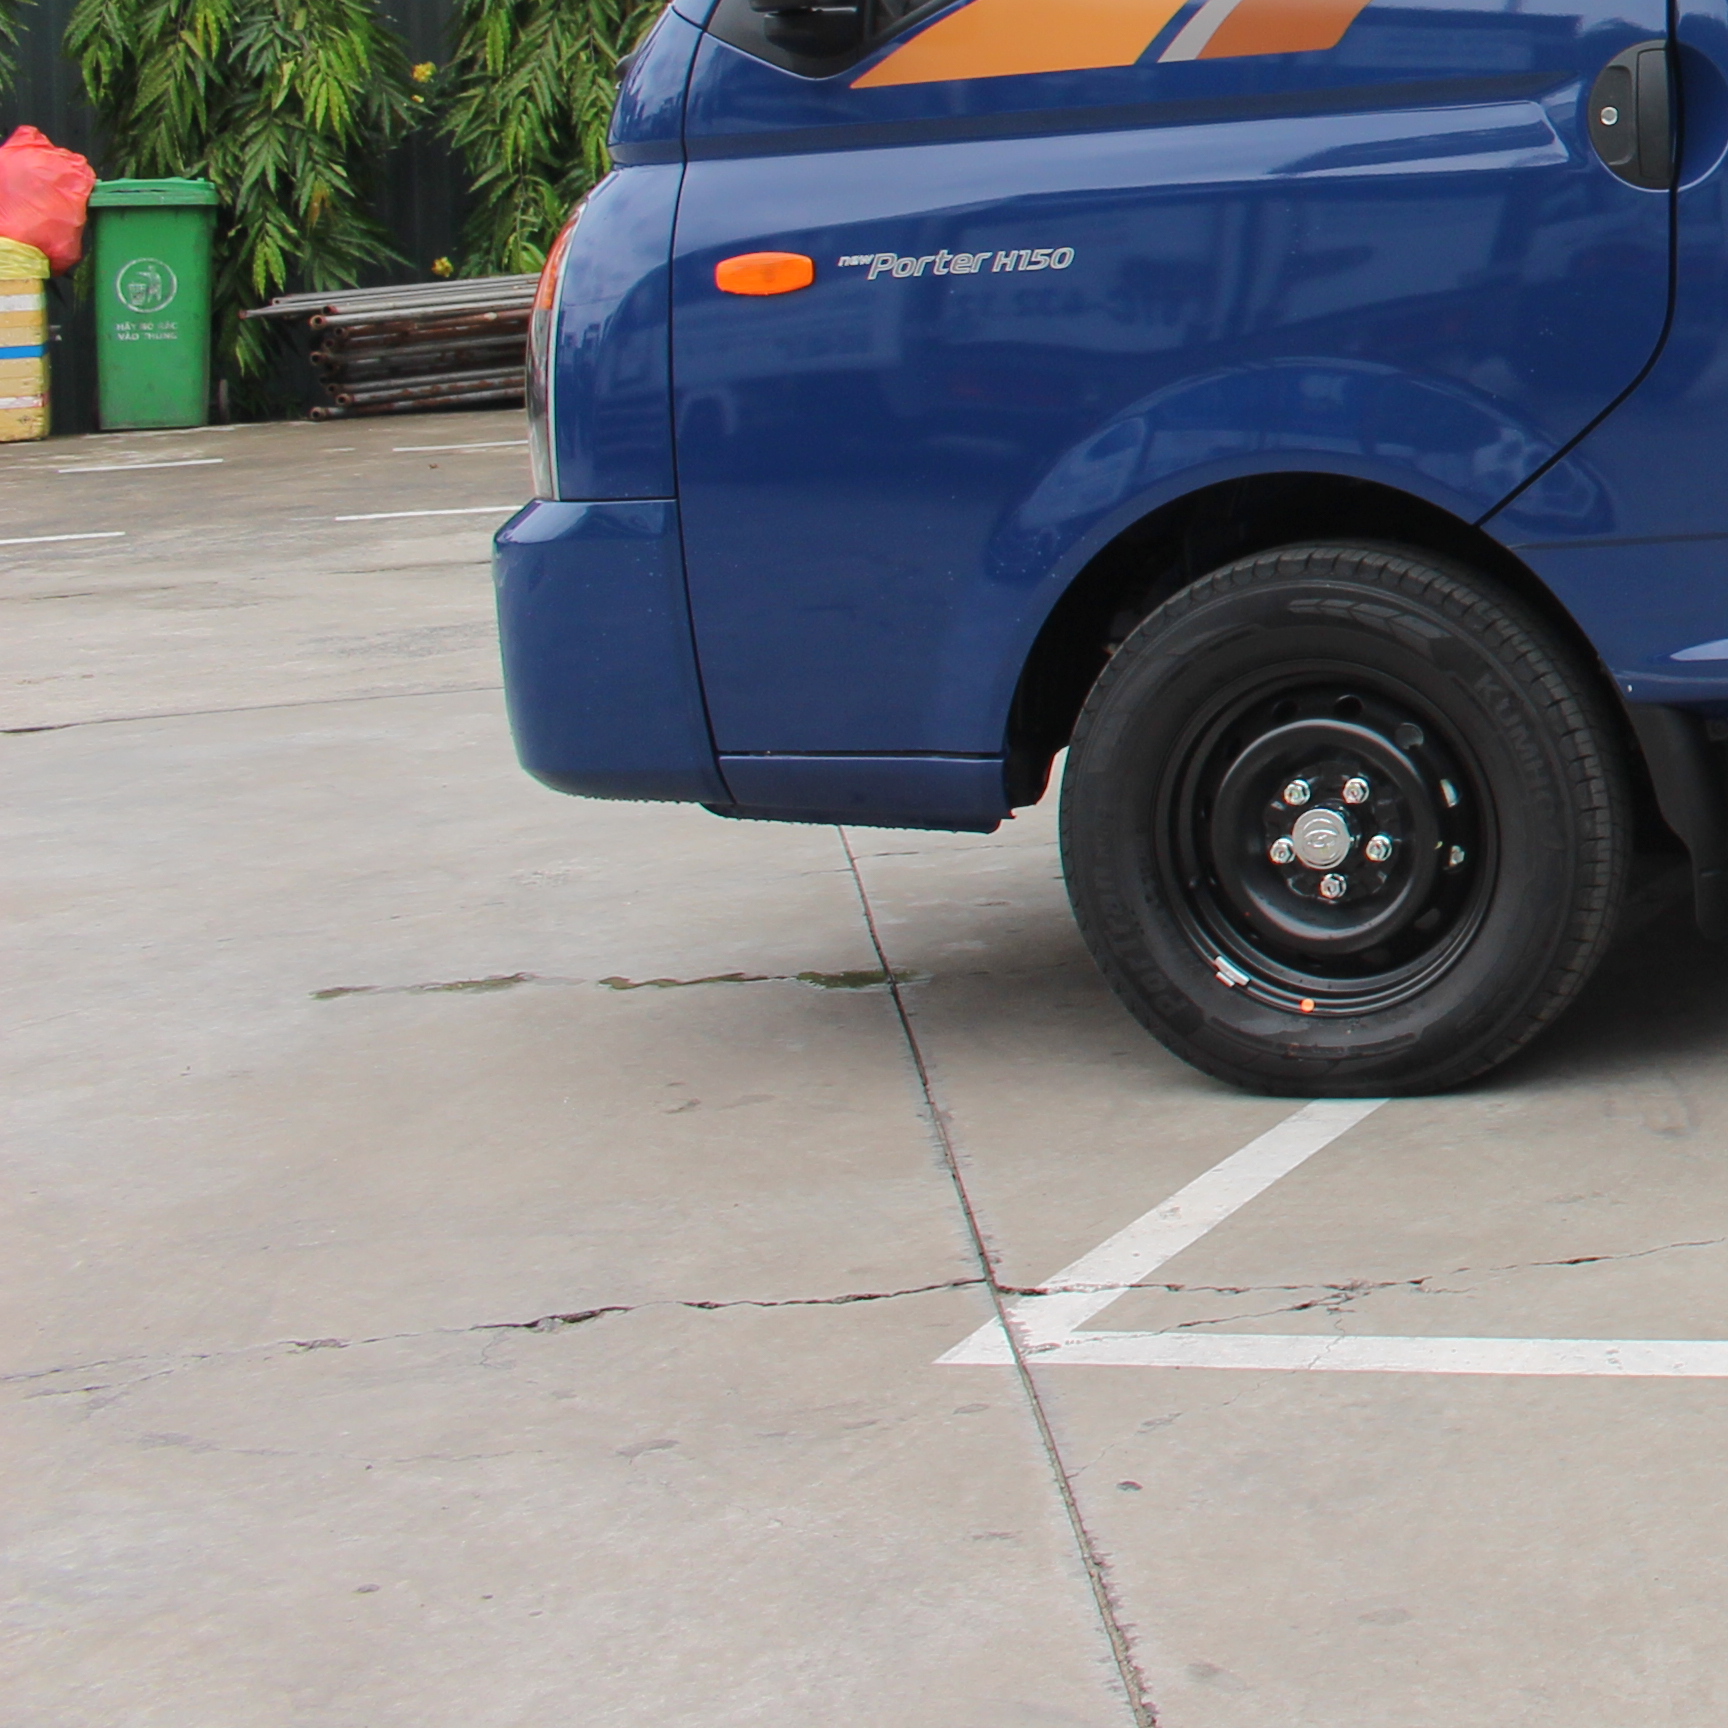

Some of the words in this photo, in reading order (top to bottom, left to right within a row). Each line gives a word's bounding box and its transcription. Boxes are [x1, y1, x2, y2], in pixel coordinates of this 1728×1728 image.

[837, 253, 875, 268] new
[866, 248, 993, 281] Porter
[991, 246, 1076, 273] H150
